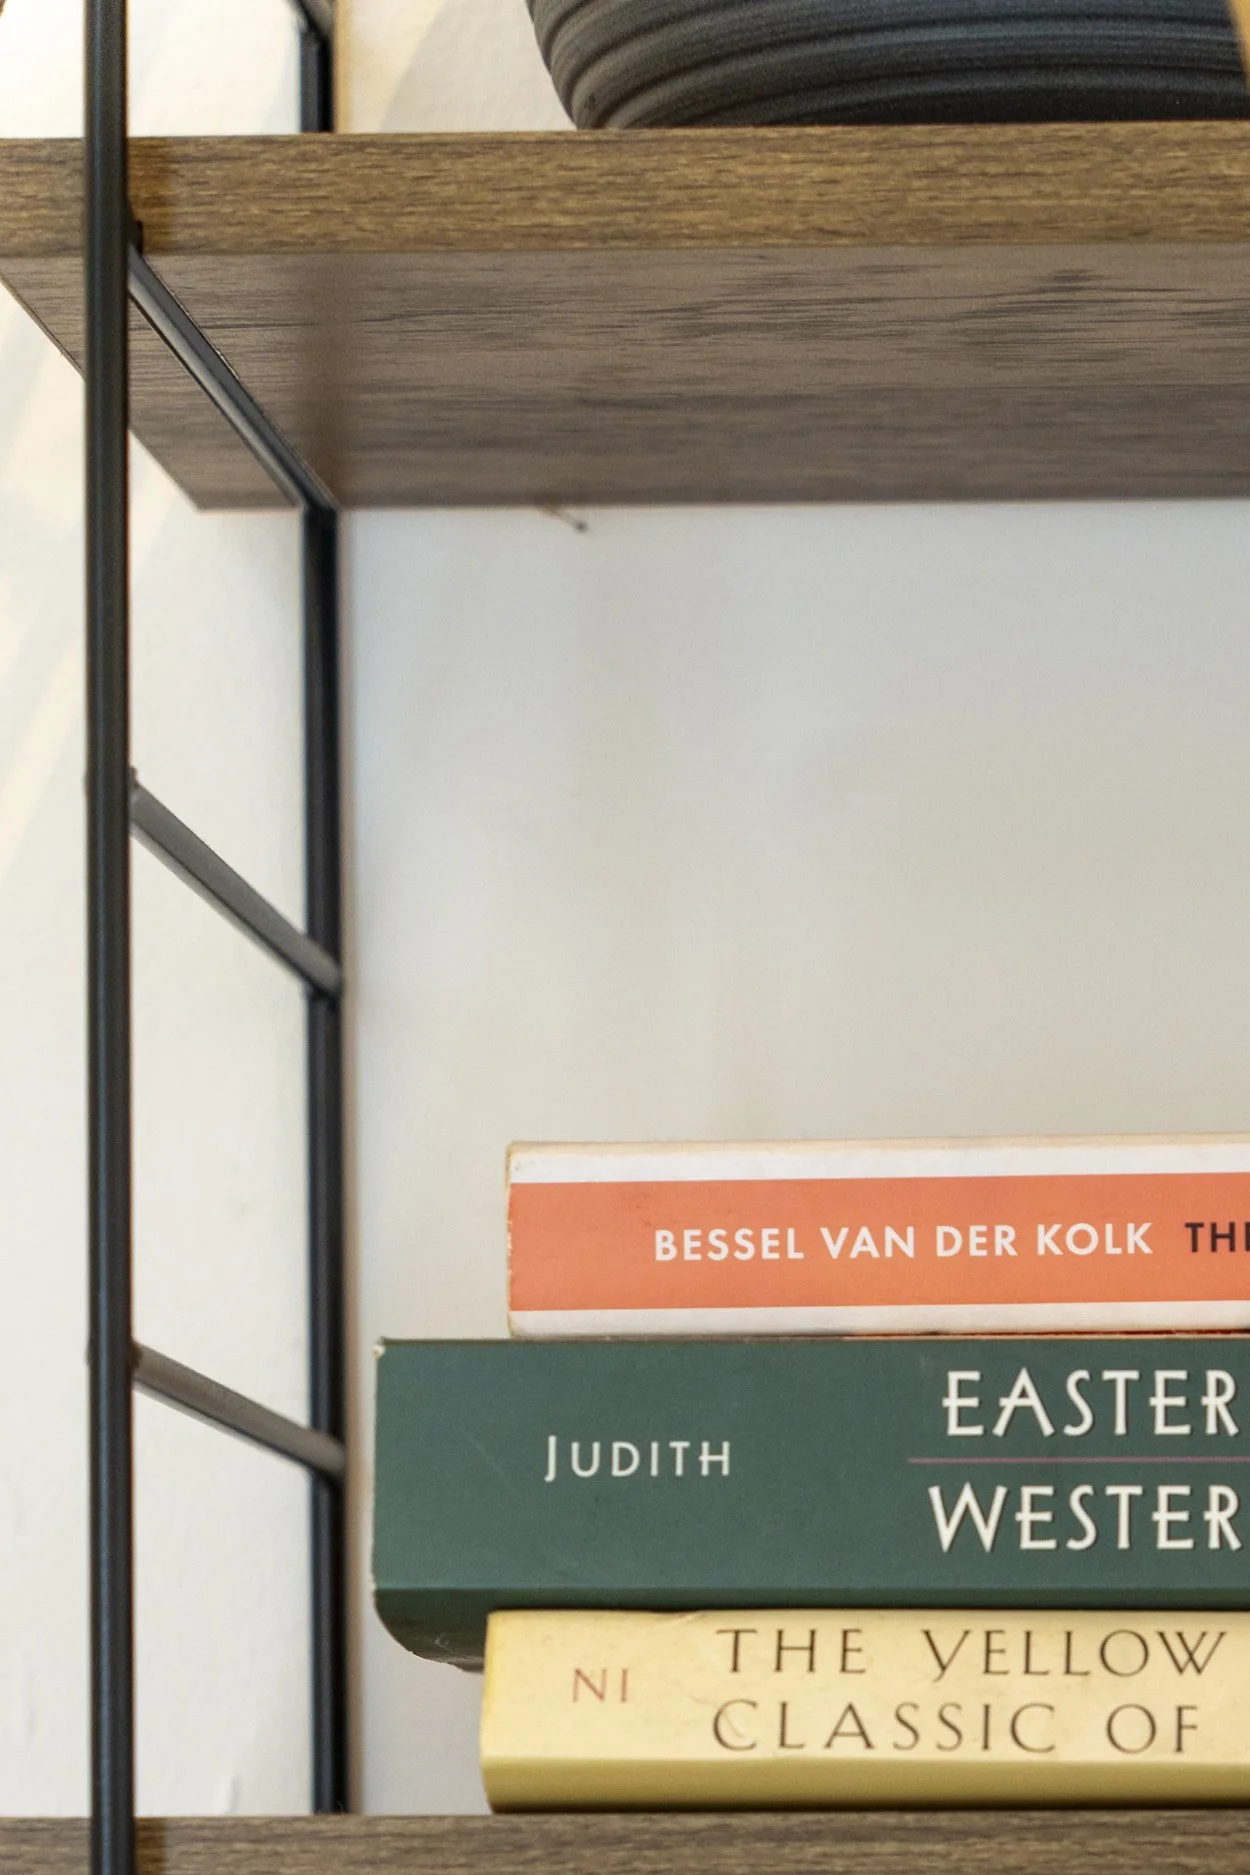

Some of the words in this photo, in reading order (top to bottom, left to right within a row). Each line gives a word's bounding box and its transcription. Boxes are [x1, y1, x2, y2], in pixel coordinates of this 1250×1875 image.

[655, 1227, 805, 1261] BESSEL
[820, 1225, 915, 1259] VAN
[936, 1224, 1018, 1258] DER
[1037, 1222, 1153, 1256] KOLK
[716, 1628, 866, 1675] THE
[922, 1629, 1227, 1682] YELLOW
[572, 1667, 629, 1703] NI
[712, 1698, 1056, 1753] CLASSIC
[1105, 1704, 1199, 1755] OF
